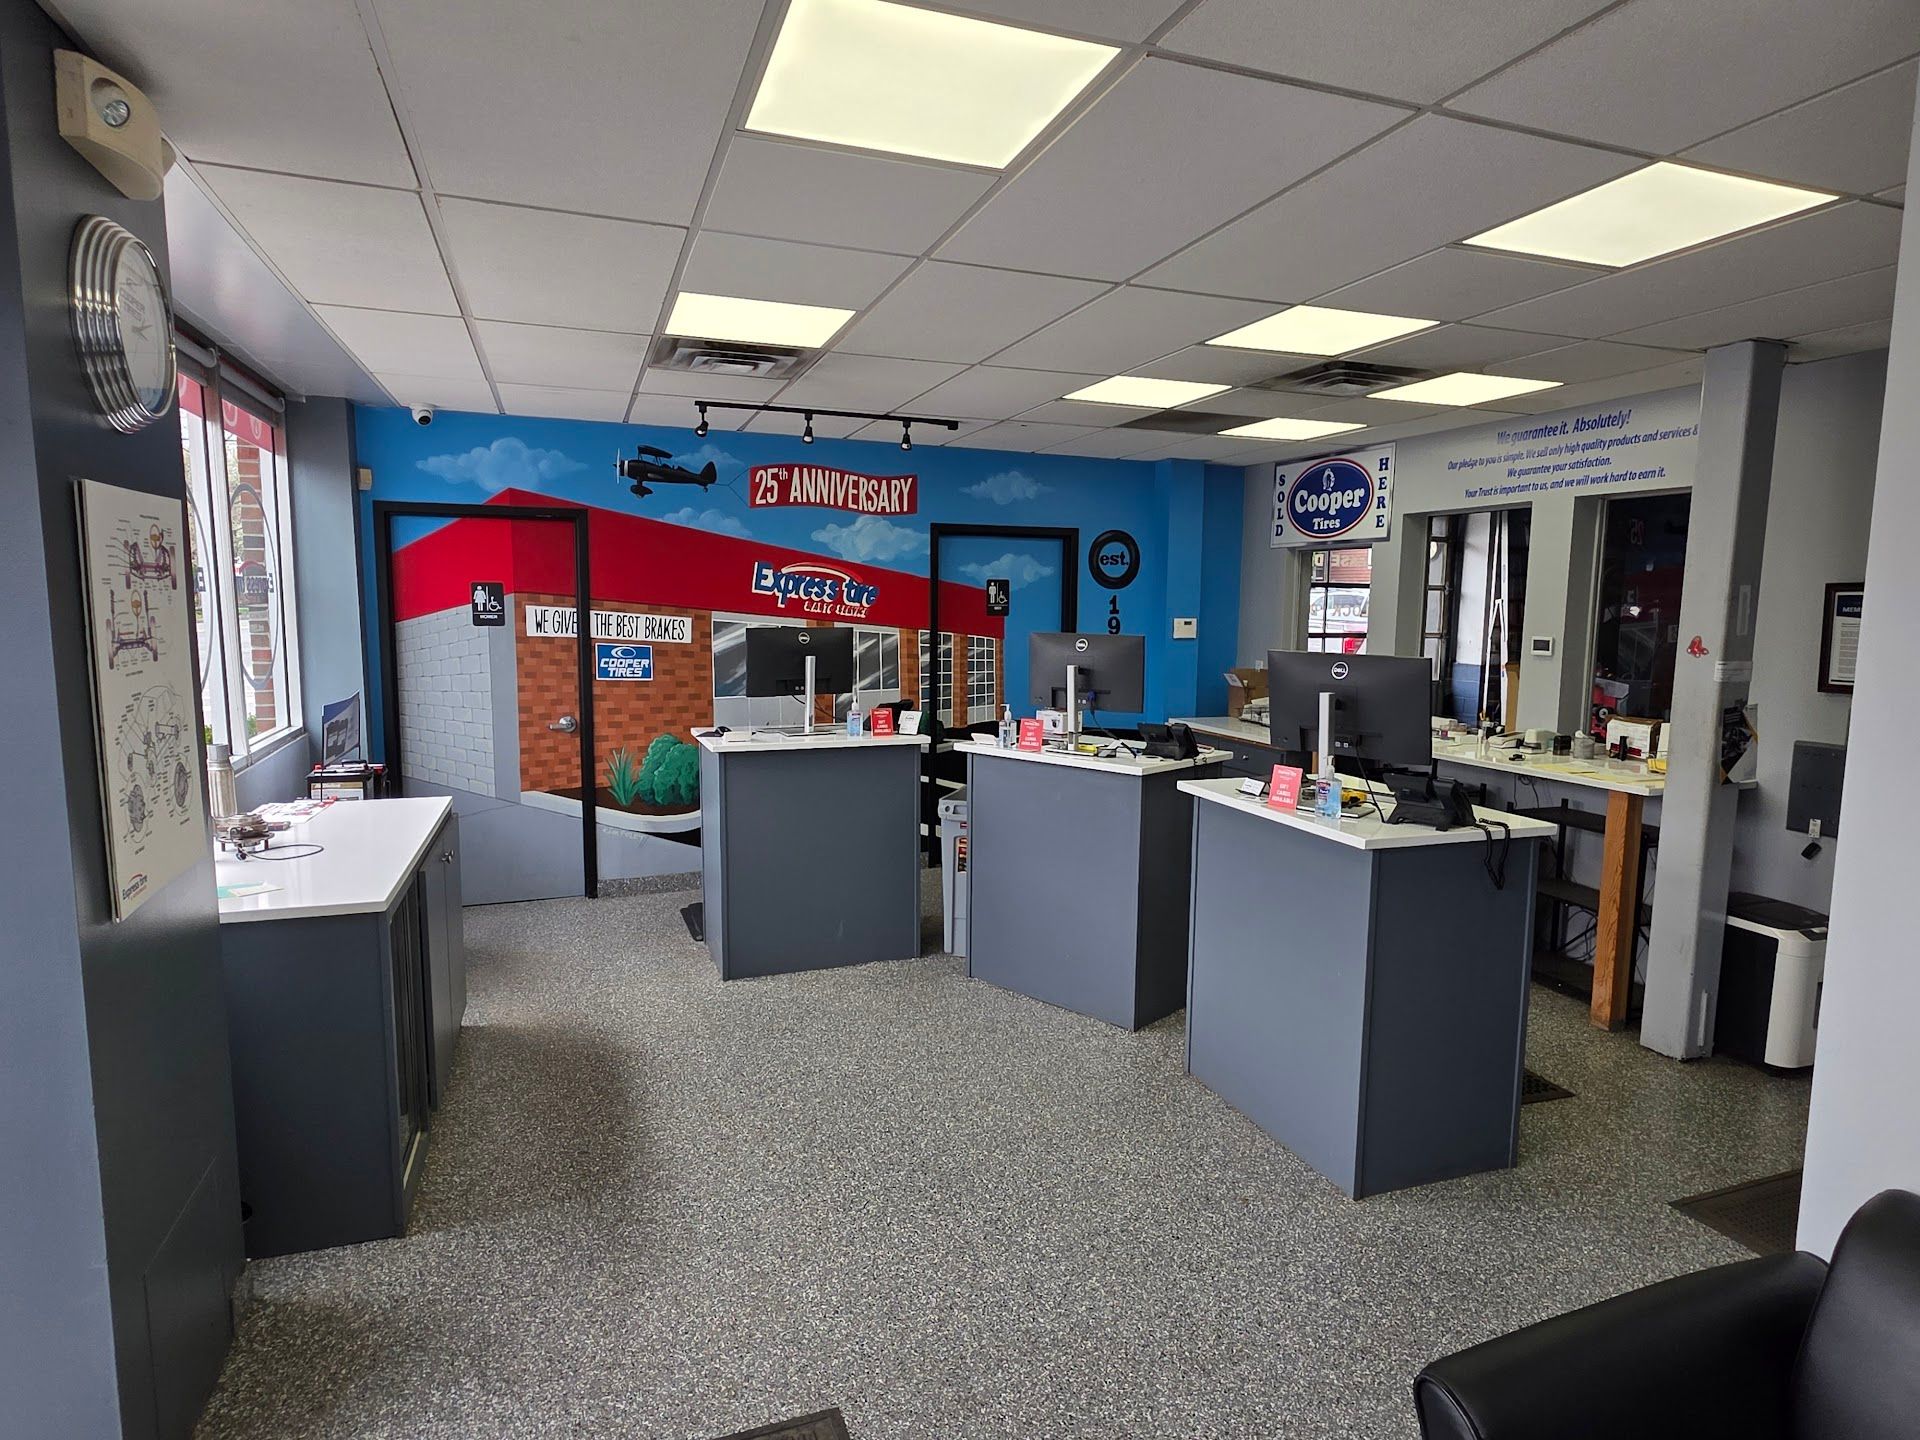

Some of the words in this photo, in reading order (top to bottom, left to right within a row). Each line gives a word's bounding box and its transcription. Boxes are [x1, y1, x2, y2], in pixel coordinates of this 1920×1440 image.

[1497, 431, 1510, 444] We
[1511, 425, 1559, 446] guarantee
[1560, 421, 1569, 435] it.
[1572, 409, 1632, 433] Absolutely!
[1448, 460, 1458, 470] Our
[1458, 458, 1477, 471] pledge
[1479, 458, 1485, 466] to
[1485, 457, 1496, 467] you
[1503, 451, 1525, 463] simple.
[1526, 448, 1537, 458] We
[1537, 446, 1549, 458] sell
[1549, 444, 1565, 457] only
[1564, 441, 1580, 455] high
[1581, 438, 1607, 454] quality
[1607, 433, 1641, 450] products
[1642, 429, 1659, 443] and
[1659, 426, 1692, 441] services
[1464, 488, 1478, 499] Your
[1478, 487, 1493, 497] Trust
[1493, 485, 1499, 495] is
[1499, 481, 1532, 497] important
[1531, 482, 1539, 491] to
[1539, 481, 1549, 491] us,
[1549, 478, 1564, 490] and
[1564, 478, 1575, 488] we
[1576, 474, 1590, 486] will
[1590, 472, 1609, 485] work
[1608, 470, 1629, 483] hard
[1628, 470, 1637, 481] to
[1637, 469, 1657, 480] earn
[1657, 466, 1666, 478] it.
[1507, 467, 1517, 478] We
[1517, 464, 1551, 479] guarantee
[1551, 462, 1568, 475] your
[1568, 455, 1612, 471] satisfaction.
[755, 467, 788, 505] 25th
[789, 467, 913, 513] ANNIVERSARY
[1275, 474, 1286, 537] SOLD
[1294, 488, 1365, 515] Cooper
[1375, 457, 1390, 529] HERE
[1312, 517, 1341, 530] Tires
[1100, 551, 1129, 566] est.
[751, 561, 838, 608] Express
[842, 578, 880, 608] tire
[535, 609, 549, 634] WE
[552, 609, 577, 634] GIVE
[594, 612, 613, 636] THE
[616, 615, 641, 638] BEST
[644, 616, 685, 641] BRAKES
[600, 658, 649, 669] COOPER
[608, 667, 642, 678] TIRES
